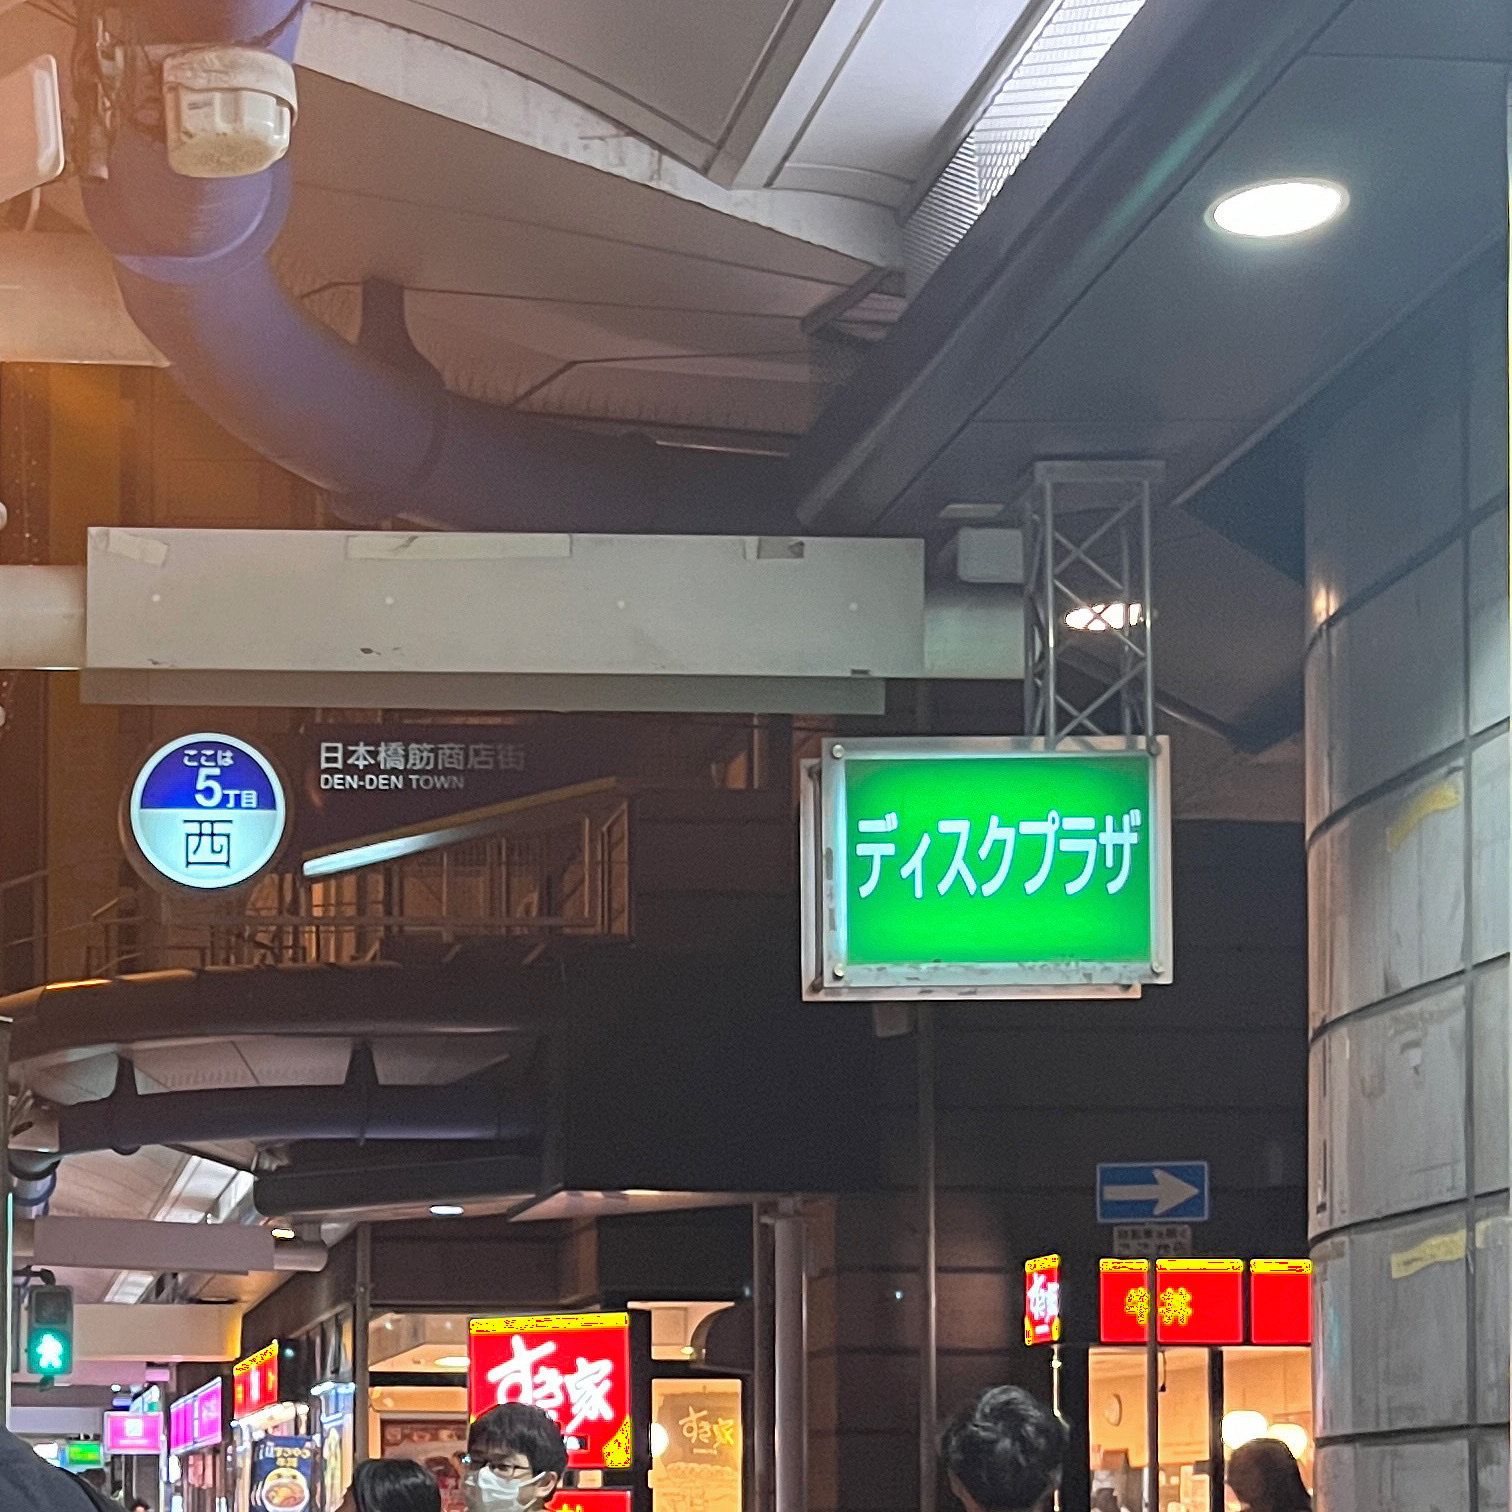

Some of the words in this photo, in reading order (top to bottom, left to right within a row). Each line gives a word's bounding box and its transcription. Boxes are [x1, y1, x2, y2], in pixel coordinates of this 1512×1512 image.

[182, 749, 235, 761] ここは
[320, 742, 524, 770] 日本橋筋商店街
[194, 767, 258, 808] 5丁目
[320, 774, 404, 790] DEN-DEN
[408, 775, 465, 790] TOWN
[182, 819, 234, 868] 西
[855, 809, 1142, 899] ディスクプラザ
[1125, 1287, 1192, 1325] 牛丼
[487, 1334, 614, 1433] すき家
[678, 1405, 734, 1449] すき家
